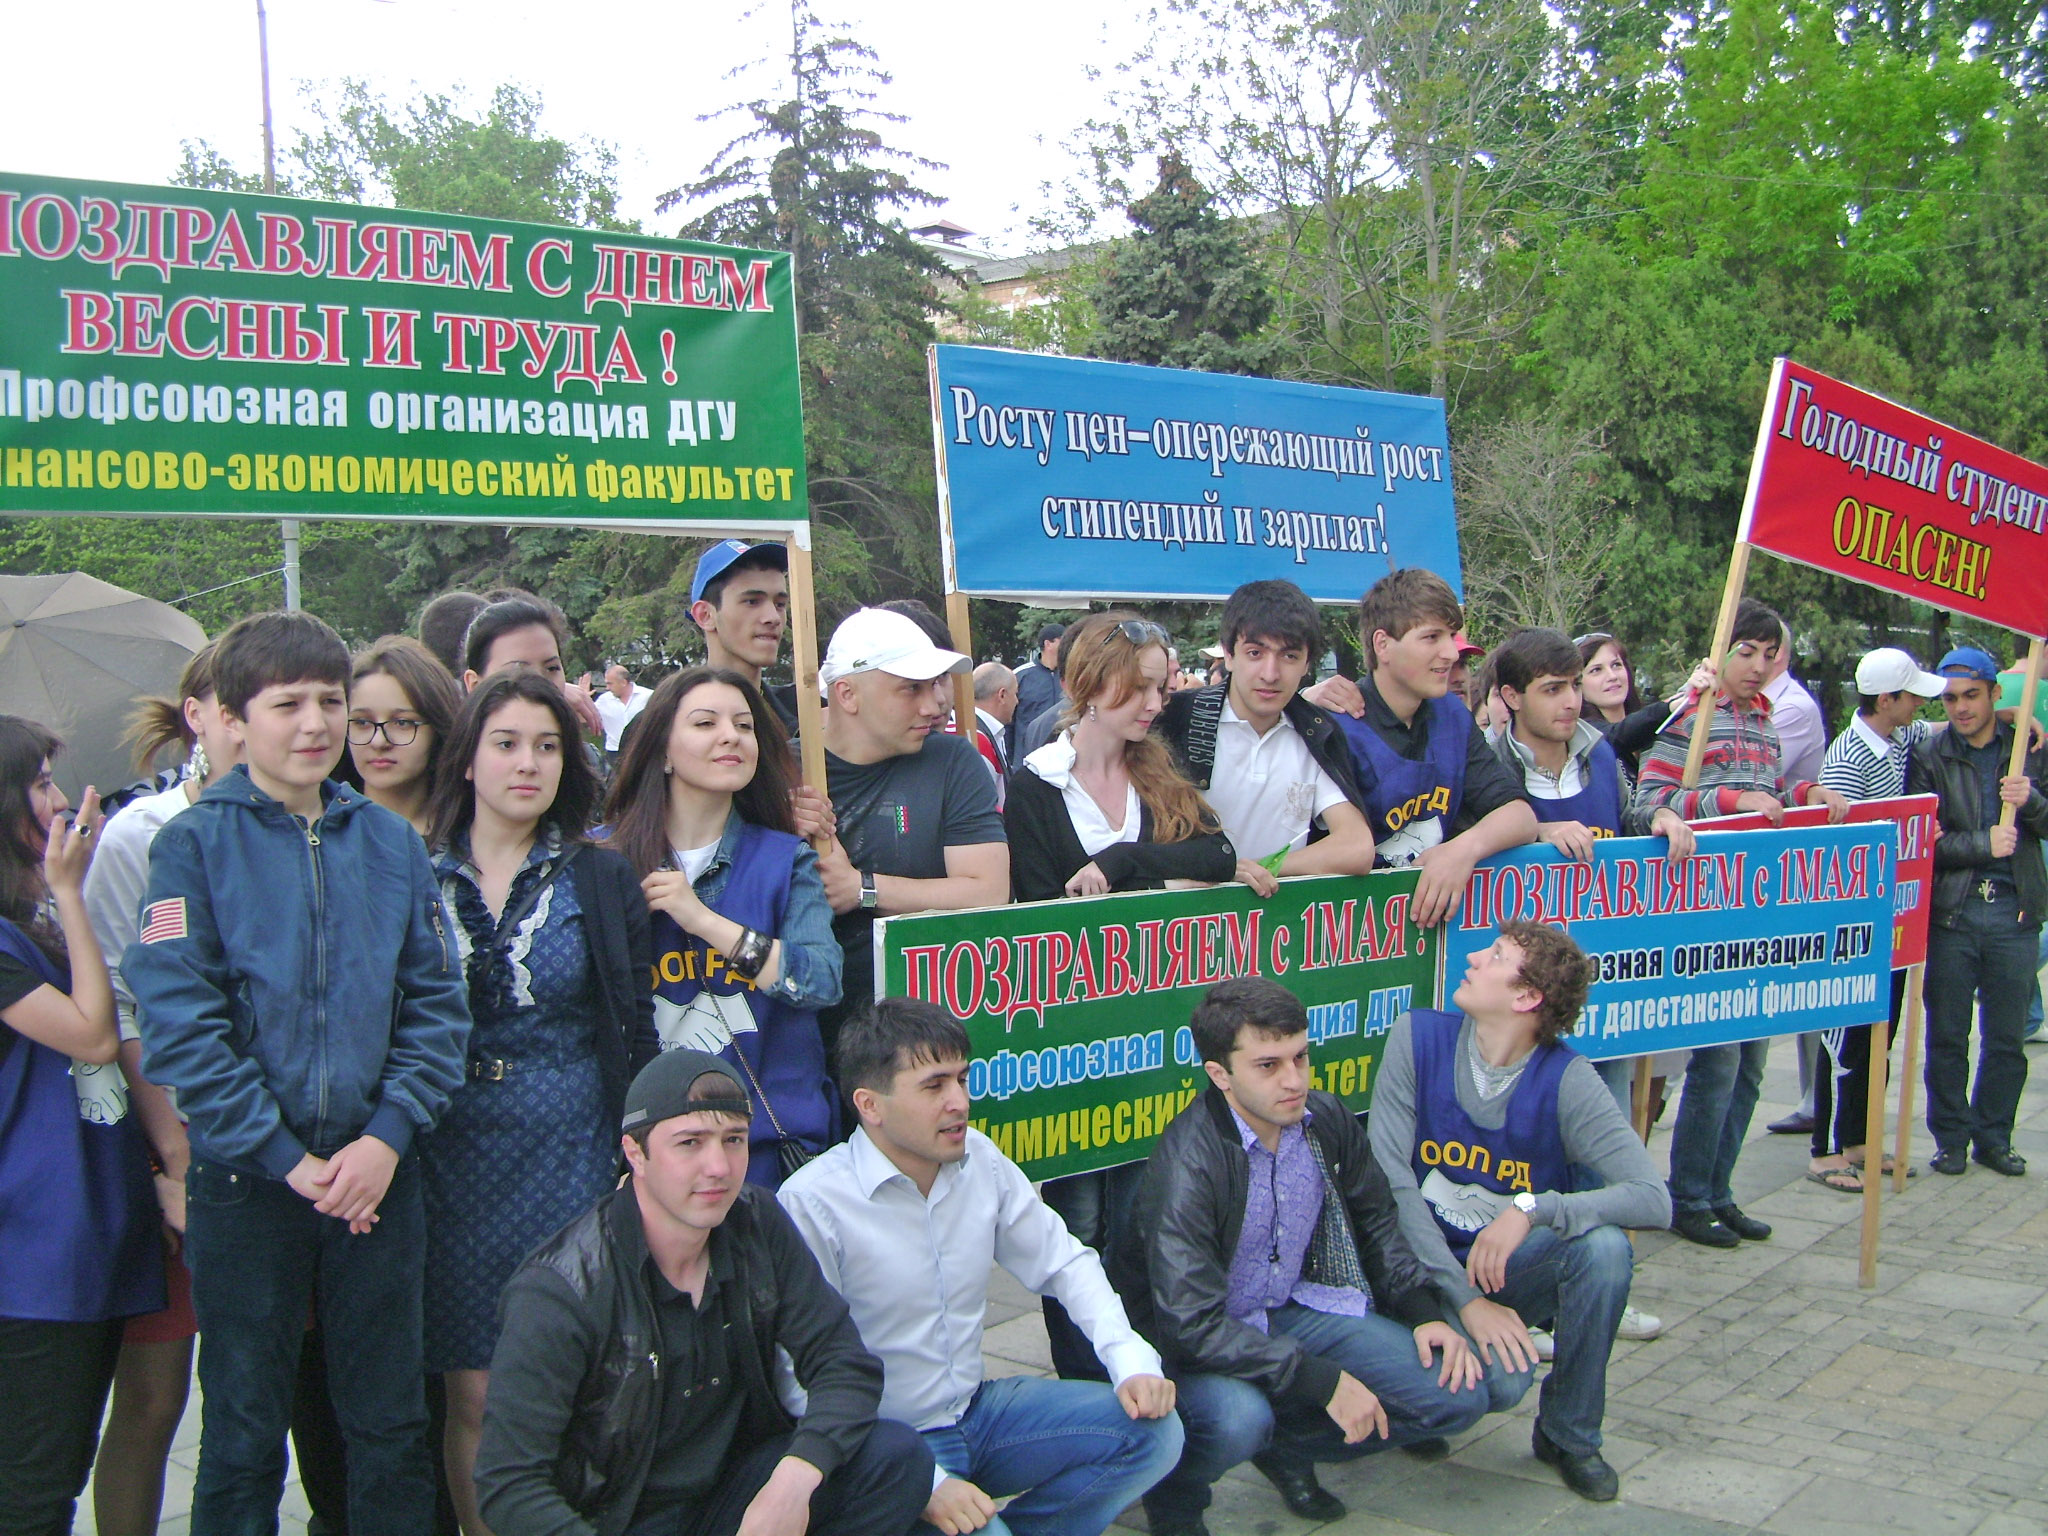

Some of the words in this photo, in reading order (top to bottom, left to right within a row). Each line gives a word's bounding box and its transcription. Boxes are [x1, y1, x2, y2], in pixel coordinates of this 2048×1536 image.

[585, 243, 774, 313] ДНЕМ
[61, 288, 350, 367] ВЕСНЫ
[363, 306, 422, 371] И
[434, 311, 647, 395] ТРУДА
[369, 388, 649, 443] организация
[949, 385, 1055, 466] Росту
[1381, 442, 1443, 492] рост
[1779, 378, 1942, 494] Голодный
[0, 443, 576, 498] нансово-экономический
[586, 457, 794, 503] факультет
[1041, 490, 1225, 551] стипендий
[1232, 508, 1255, 546] и
[1261, 504, 1389, 565] зарплат!
[1832, 497, 1993, 601] ОПАСЕН!
[1459, 849, 1747, 935] ПОЗДРАВЛЯЕМ
[1777, 845, 1870, 906] 1МАЯ
[901, 908, 1263, 1032] ПОЗДРАВЛЯЕМ
[1299, 893, 1410, 972] 1МАЯ
[1672, 931, 1826, 979] организация
[1603, 983, 1758, 1040] дагестанской
[1762, 973, 1876, 1019] филологии
[968, 1030, 1164, 1101] офсоюзная
[1420, 1139, 1492, 1174] ООП
[1496, 1159, 1533, 1193] РД
